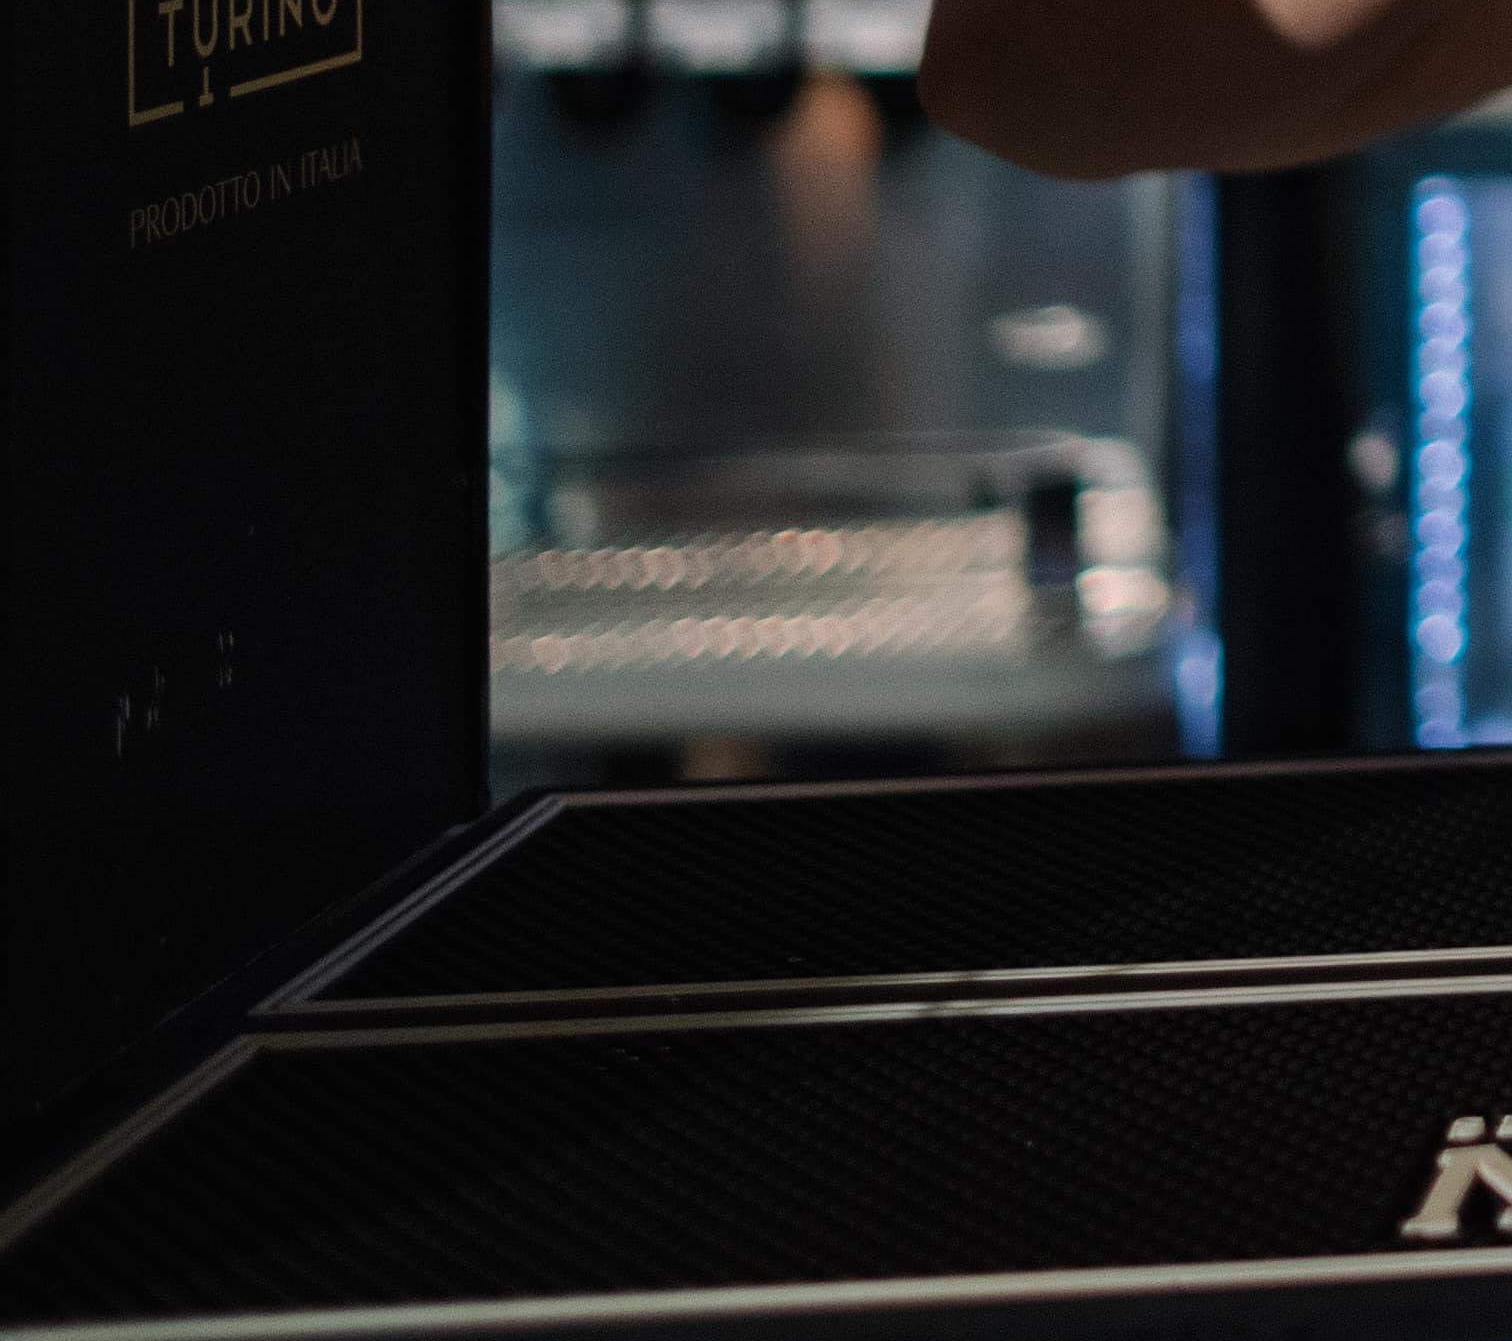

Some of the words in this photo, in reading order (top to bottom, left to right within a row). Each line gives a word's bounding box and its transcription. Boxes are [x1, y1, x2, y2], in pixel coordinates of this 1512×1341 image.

[130, 170, 261, 249] PRODOTTO
[271, 164, 291, 200] IN
[302, 138, 363, 188] ITALIA
